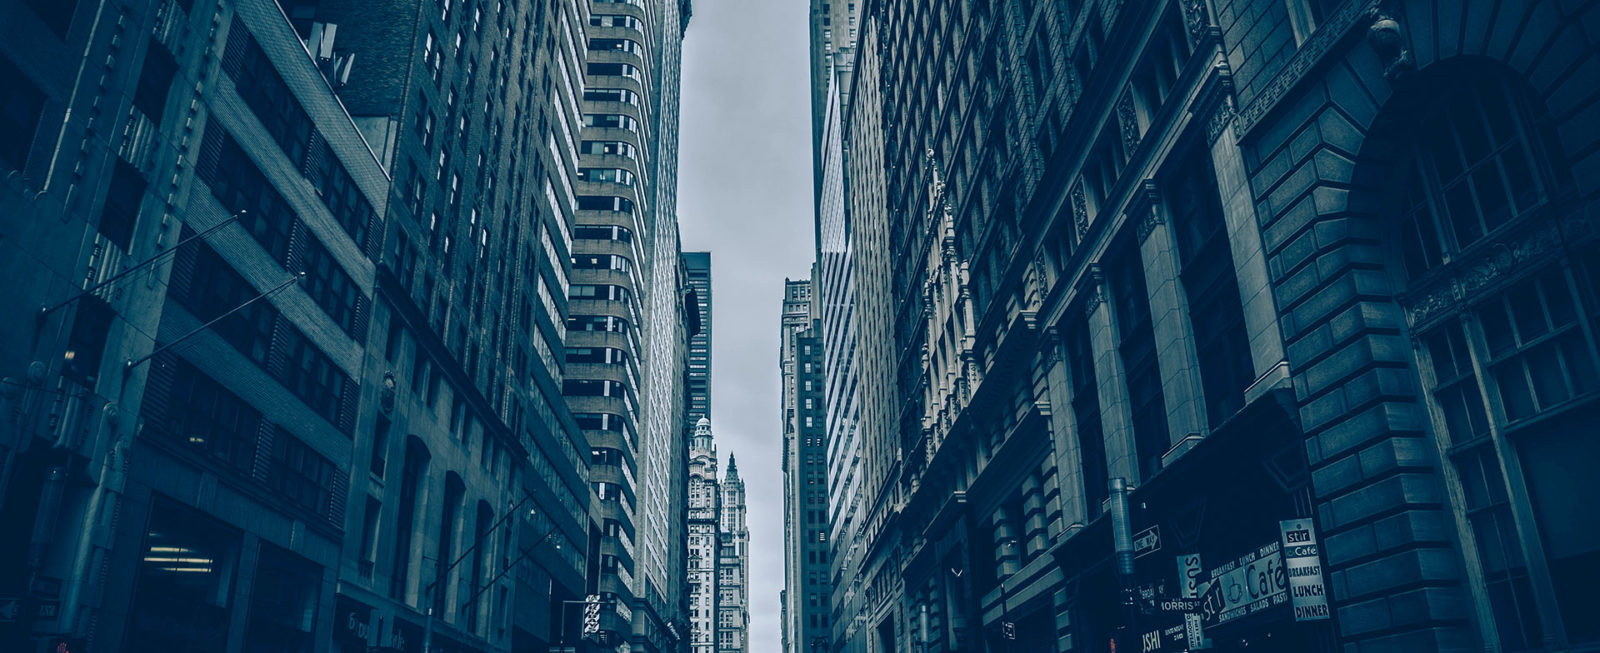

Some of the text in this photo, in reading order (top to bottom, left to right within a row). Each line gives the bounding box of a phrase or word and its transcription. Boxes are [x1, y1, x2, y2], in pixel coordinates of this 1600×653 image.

[1288, 531, 1307, 542] stir
[1295, 545, 1317, 556] Café
[1211, 560, 1236, 578] BREAKFAST
[1239, 552, 1256, 567] LUNCH
[1288, 566, 1320, 577] BREAKFAST
[1246, 558, 1286, 600] Café
[1293, 584, 1323, 597] LUNCH
[1219, 606, 1247, 622] SANDWICHES
[1250, 598, 1269, 613] SALADS
[1296, 604, 1329, 618] DINNER
